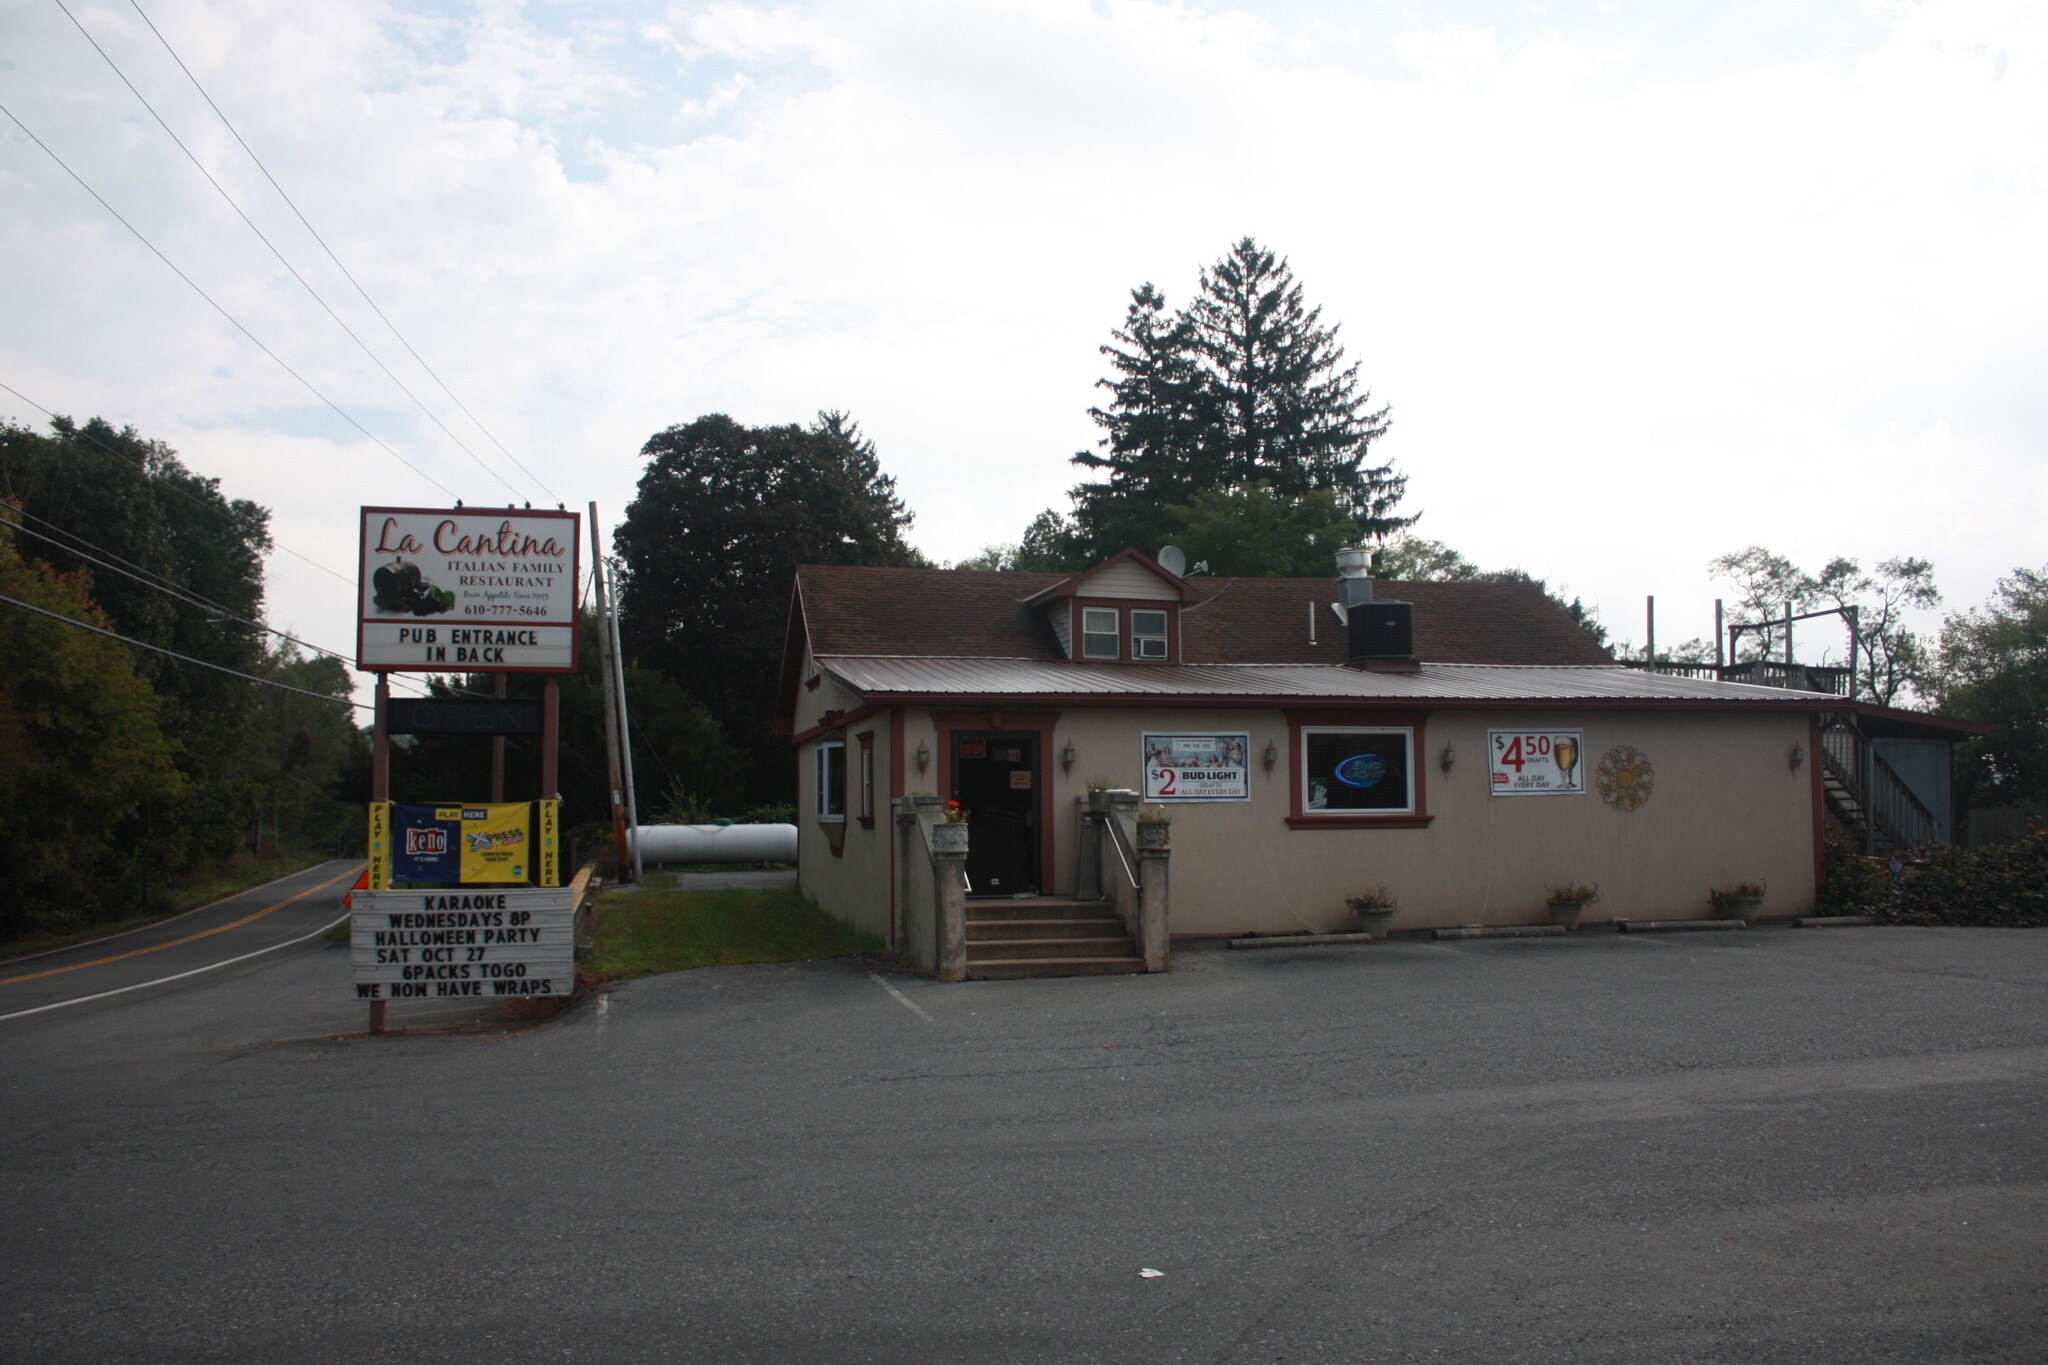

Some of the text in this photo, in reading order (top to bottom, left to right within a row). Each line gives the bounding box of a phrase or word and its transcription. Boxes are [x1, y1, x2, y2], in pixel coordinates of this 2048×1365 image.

[375, 517, 567, 558] La Cantina
[448, 561, 566, 574] ITALIAN FAMILY
[460, 575, 554, 588] RESTAURANT
[513, 591, 530, 599] Since
[464, 605, 547, 616] 610-777-5646
[400, 628, 538, 645] PUB ENTRANCE
[427, 647, 504, 663] IN BACK
[1152, 768, 1176, 795] $2
[1182, 772, 1238, 780] BUD LIGHT
[438, 810, 486, 819] PLAY HERE
[372, 805, 383, 889] PLAY HERE
[544, 802, 553, 885] PLAY HERE
[425, 896, 506, 910] KARAOKE
[389, 912, 531, 928] WEDNESDAYS 8P
[376, 928, 540, 946] HALLOWEEN PARTY
[377, 947, 486, 963] SAT OCT 27
[402, 964, 526, 980] 6PACKS TOGO
[357, 980, 552, 998] WE NOW HAVE WRAPS
